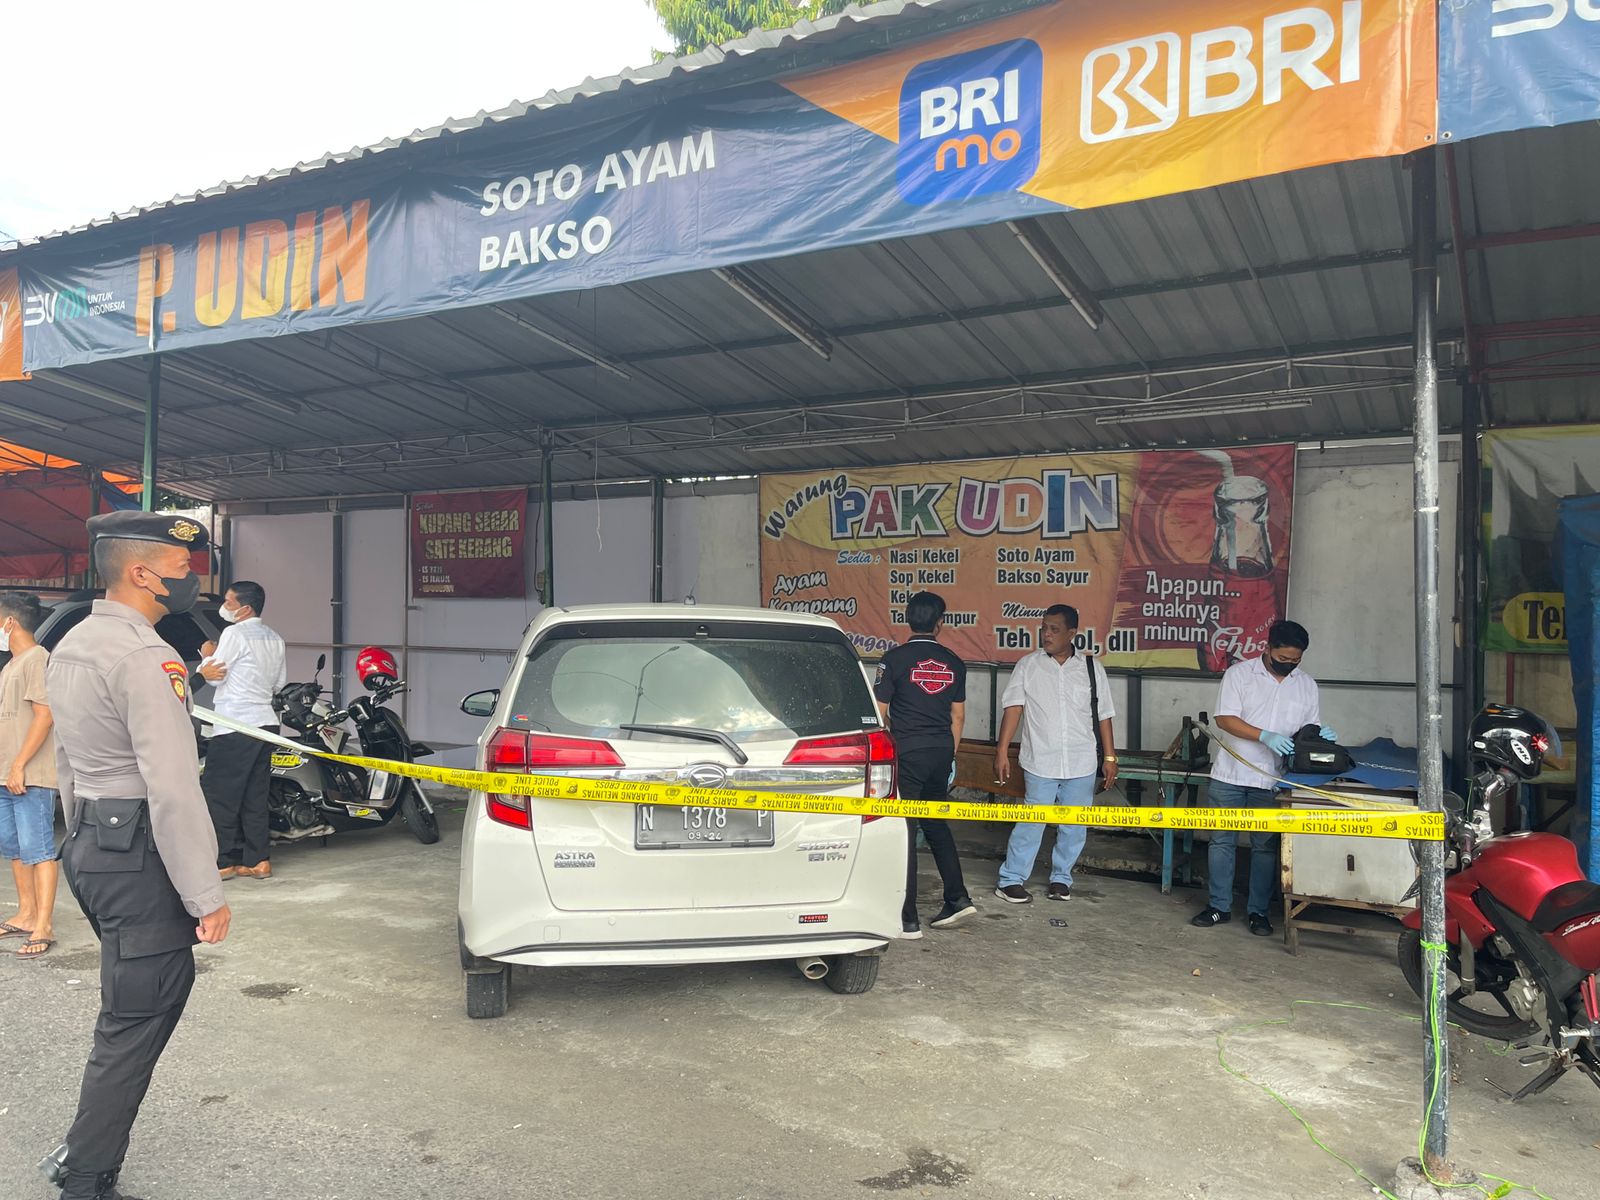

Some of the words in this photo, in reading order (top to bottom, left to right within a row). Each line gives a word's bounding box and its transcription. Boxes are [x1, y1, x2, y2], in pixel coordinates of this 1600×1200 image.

[1188, 1, 1362, 117] BRI
[920, 69, 1019, 139] BRI
[935, 128, 1022, 171] mo
[480, 163, 583, 217] SOTO
[595, 130, 715, 193] AYAM
[479, 215, 612, 272] BAKSO
[136, 243, 176, 337] P.
[194, 198, 371, 327] UDIN
[87, 291, 113, 304] UNTUK
[89, 300, 126, 317] INDONESIA
[764, 473, 848, 538] Warung
[829, 482, 952, 541] PAK
[955, 468, 1120, 541] UDIN
[419, 512, 471, 534] KUPANG
[475, 510, 519, 531] SEGAR
[425, 538, 456, 559] SATE
[459, 536, 512, 558] KERANG
[837, 550, 873, 564] Sedia
[889, 550, 918, 563] Nasi
[922, 549, 959, 563] Kekel
[997, 548, 1029, 563] Soto
[1034, 548, 1075, 565] Ayam
[889, 570, 914, 586] Sop
[917, 569, 954, 583] Kekel
[997, 569, 1041, 583] Bakso
[1046, 568, 1089, 586] Sayur
[772, 570, 828, 596] Ayam
[1146, 570, 1241, 600] Apapun...
[1142, 596, 1220, 624] enaknya
[1144, 621, 1208, 642] minum
[995, 628, 1031, 648] Teh
[1108, 630, 1135, 651] dll
[514, 775, 532, 784] LINE
[533, 776, 560, 786] POLICE
[594, 781, 621, 789] CROSS
[510, 785, 535, 796] POLISI
[537, 786, 560, 796] GARIS
[622, 782, 638, 791] NOT
[638, 782, 650, 791] DO
[689, 787, 710, 795] LINE
[582, 789, 618, 800] MELINTAS
[620, 790, 658, 802] DILARANG
[711, 788, 738, 797] POLICE
[683, 795, 711, 805] POLISI
[712, 796, 738, 806] GARIS
[761, 799, 800, 810] MELINTAS
[802, 800, 843, 812] DILARANG
[870, 804, 900, 814] POLISI
[902, 805, 930, 816] GARIS
[1104, 806, 1137, 814] POLICE
[955, 808, 999, 819] MELINTAS
[1001, 810, 1046, 821] DILARANG
[1183, 808, 1215, 816] CROSS
[1218, 809, 1238, 817] NOT
[1240, 810, 1255, 818] DO
[1306, 811, 1329, 821] LINE
[1331, 812, 1369, 822] POLICE
[642, 806, 654, 830] N
[681, 806, 727, 829] 1378
[757, 810, 767, 827] P
[1076, 814, 1108, 824] POLISI
[1111, 815, 1141, 825] GARIS
[1170, 817, 1217, 828] MELINTAS
[1220, 819, 1268, 830] DILARANG
[1301, 822, 1336, 833] POLISI
[1340, 823, 1373, 834] GARIS
[554, 851, 596, 860] ASTRA
